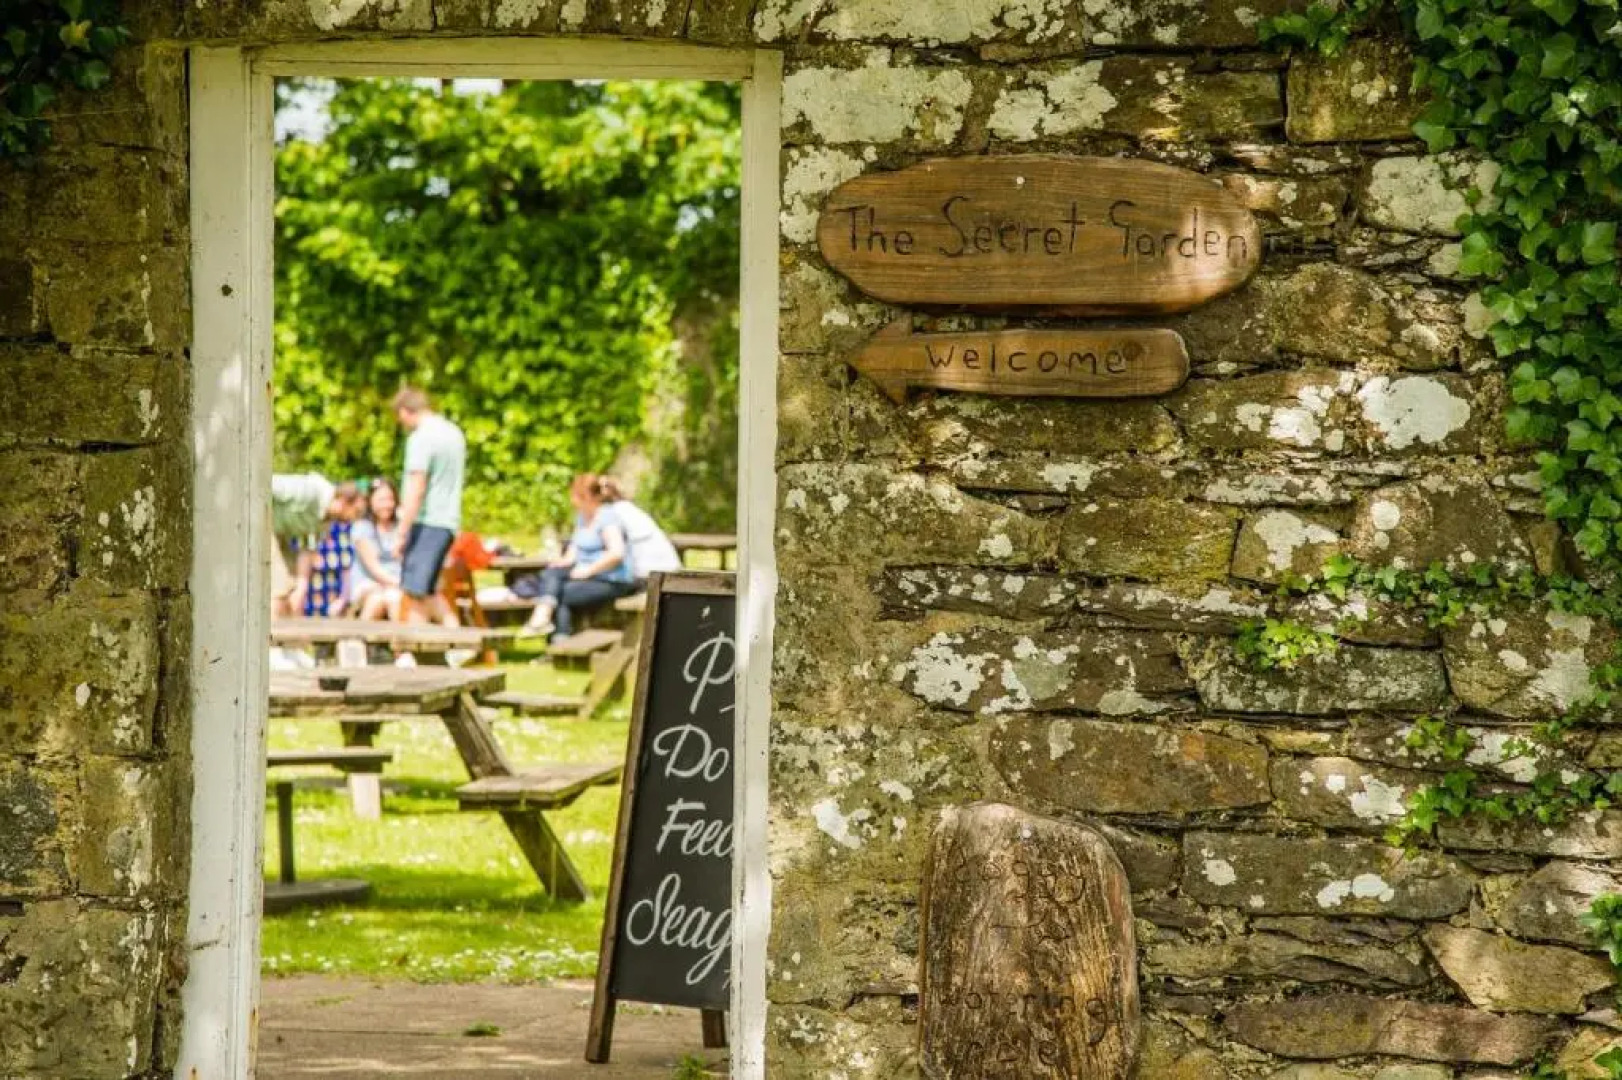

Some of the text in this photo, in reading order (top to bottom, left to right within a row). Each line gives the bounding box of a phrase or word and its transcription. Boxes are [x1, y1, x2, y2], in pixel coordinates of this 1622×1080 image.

[833, 196, 1247, 260] The Secret Garden
[653, 723, 730, 782] Do
